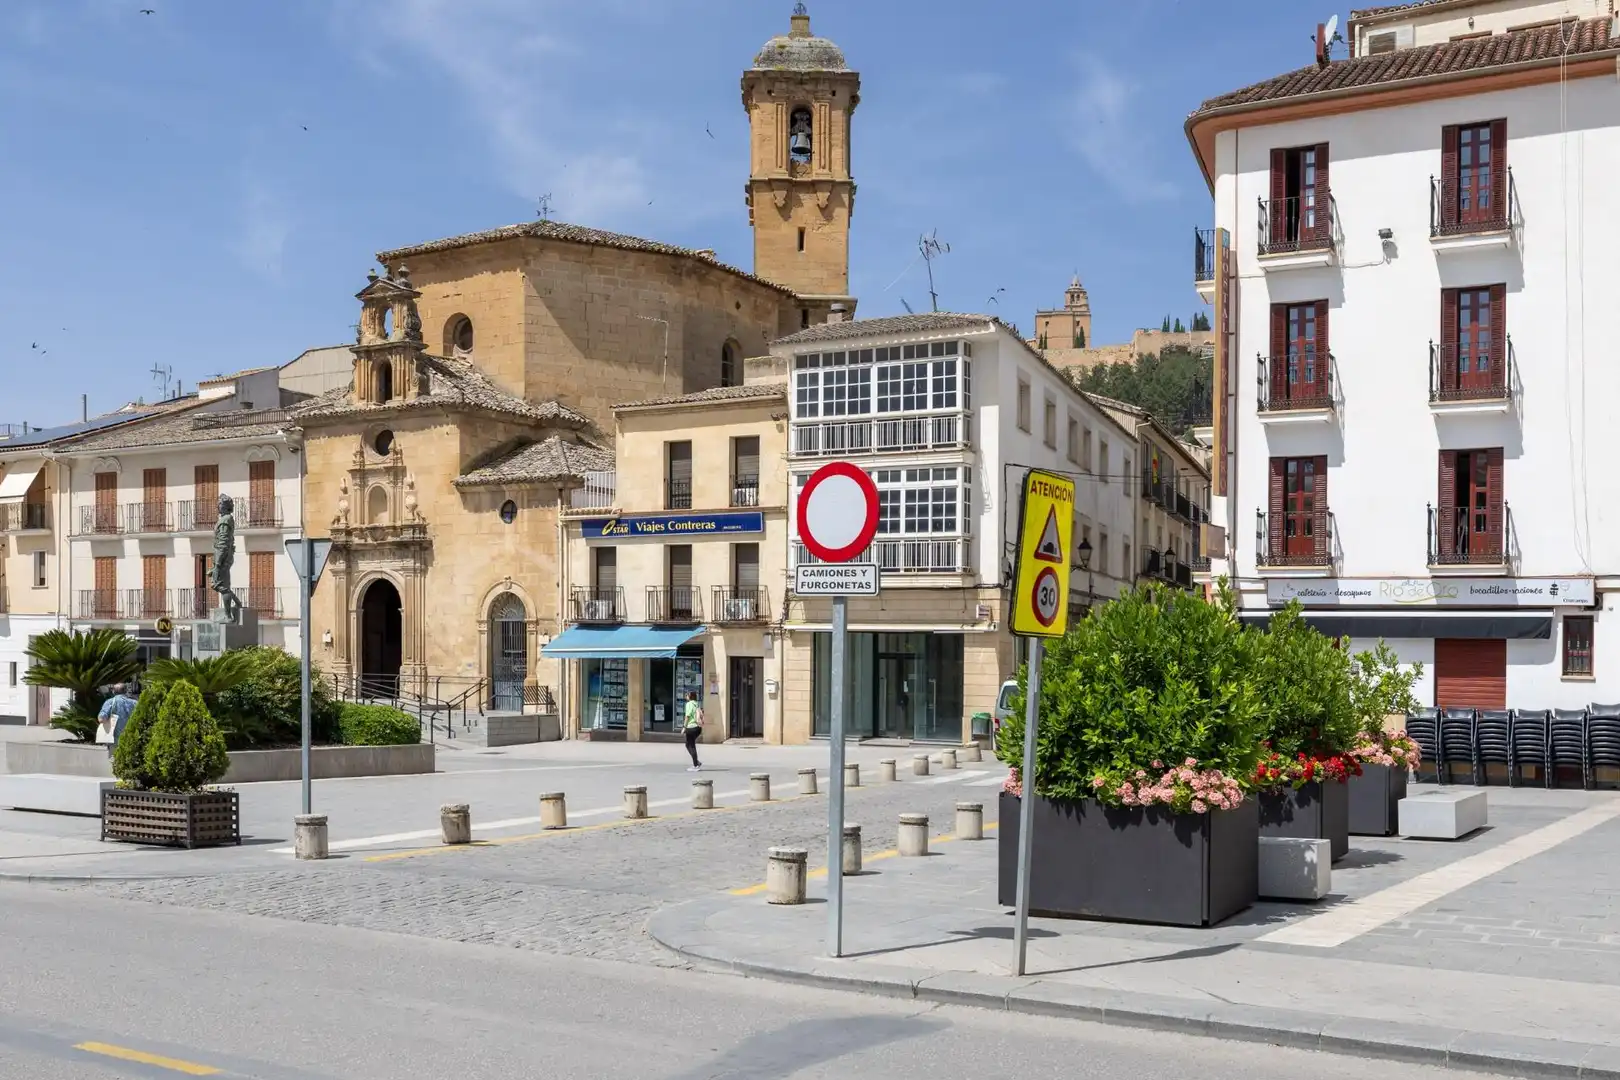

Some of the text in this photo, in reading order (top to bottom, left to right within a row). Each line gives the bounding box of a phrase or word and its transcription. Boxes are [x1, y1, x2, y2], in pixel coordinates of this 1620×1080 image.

[1030, 480, 1073, 503] ATENCIÓN
[636, 521, 665, 532] Viajes
[668, 520, 716, 531] Contreras
[802, 569, 868, 577] CAMIONES Y
[800, 581, 872, 590] FURGONETAS
[1408, 586, 1424, 597] de
[1427, 581, 1459, 597] Oro
[1040, 586, 1056, 608] 30
[1335, 587, 1372, 599] desayunos
[159, 621, 170, 630] IN
